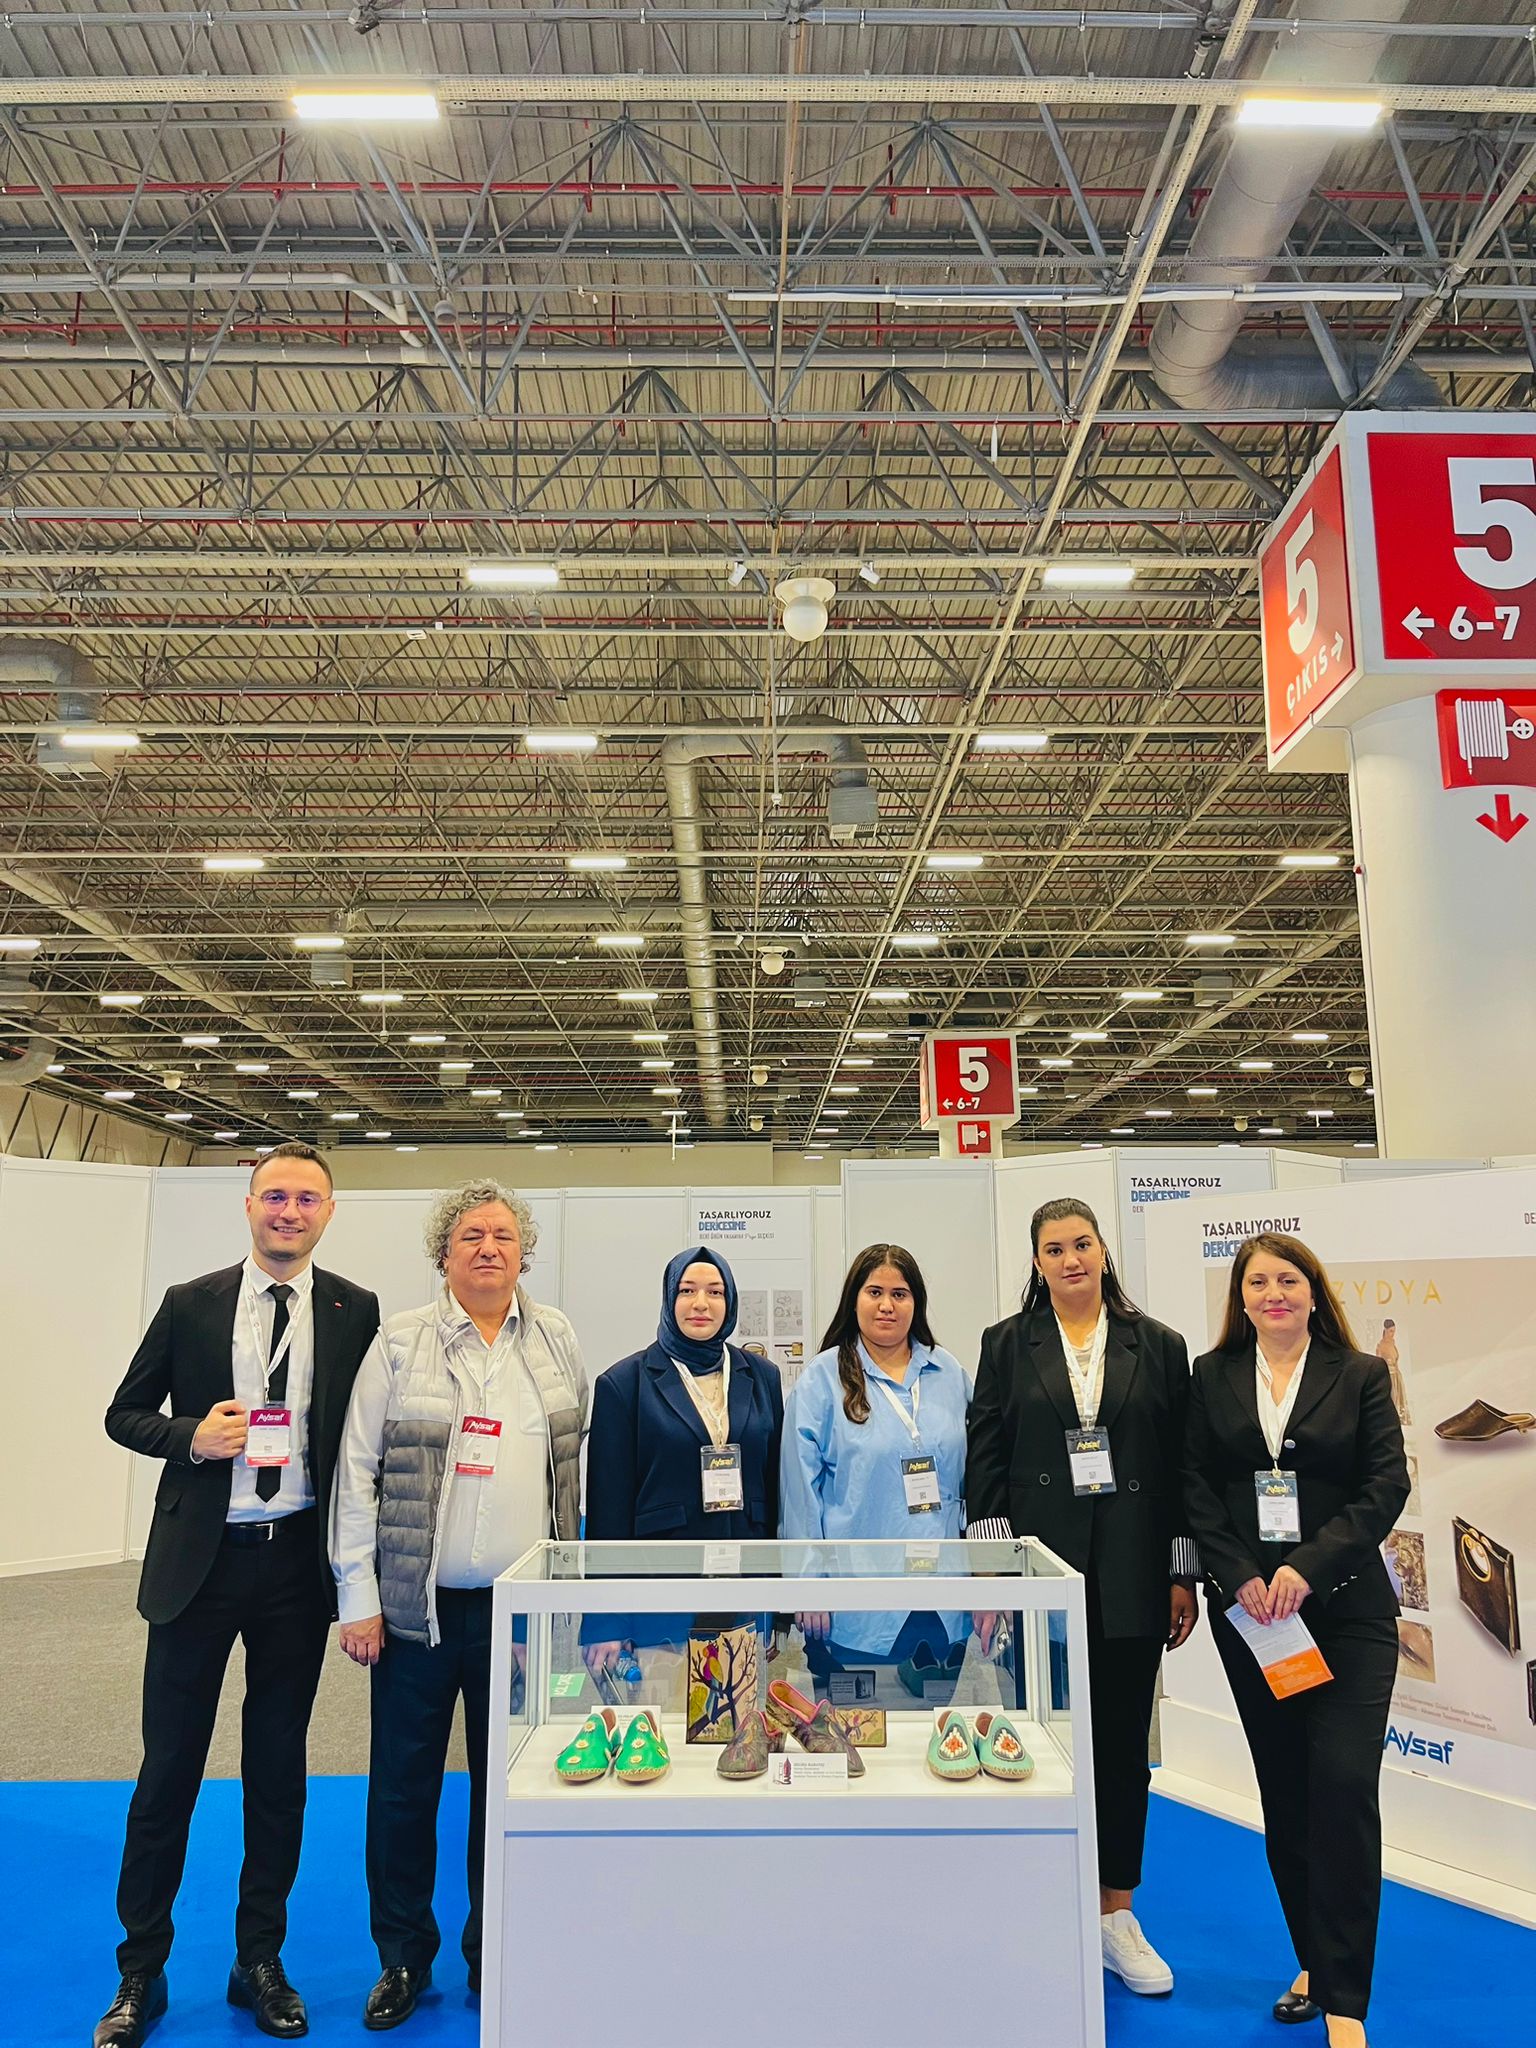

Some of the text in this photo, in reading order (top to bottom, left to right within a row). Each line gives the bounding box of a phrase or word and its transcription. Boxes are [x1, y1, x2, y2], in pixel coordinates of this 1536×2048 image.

[1447, 457, 1536, 590] 5
[1284, 508, 1319, 655] 5
[1449, 606, 1520, 641] 6-7
[958, 1047, 990, 1093] 5
[956, 1097, 981, 1110] 6-7
[1130, 1177, 1222, 1188] TASARLIYORUZ
[698, 1210, 772, 1220] TASARLIYORUZ
[1132, 1205, 1144, 1214] DER
[1524, 1212, 1536, 1225] DE
[1202, 1217, 1302, 1237] TASARLIYORUZ
[1384, 1725, 1455, 1765] Aysaf
